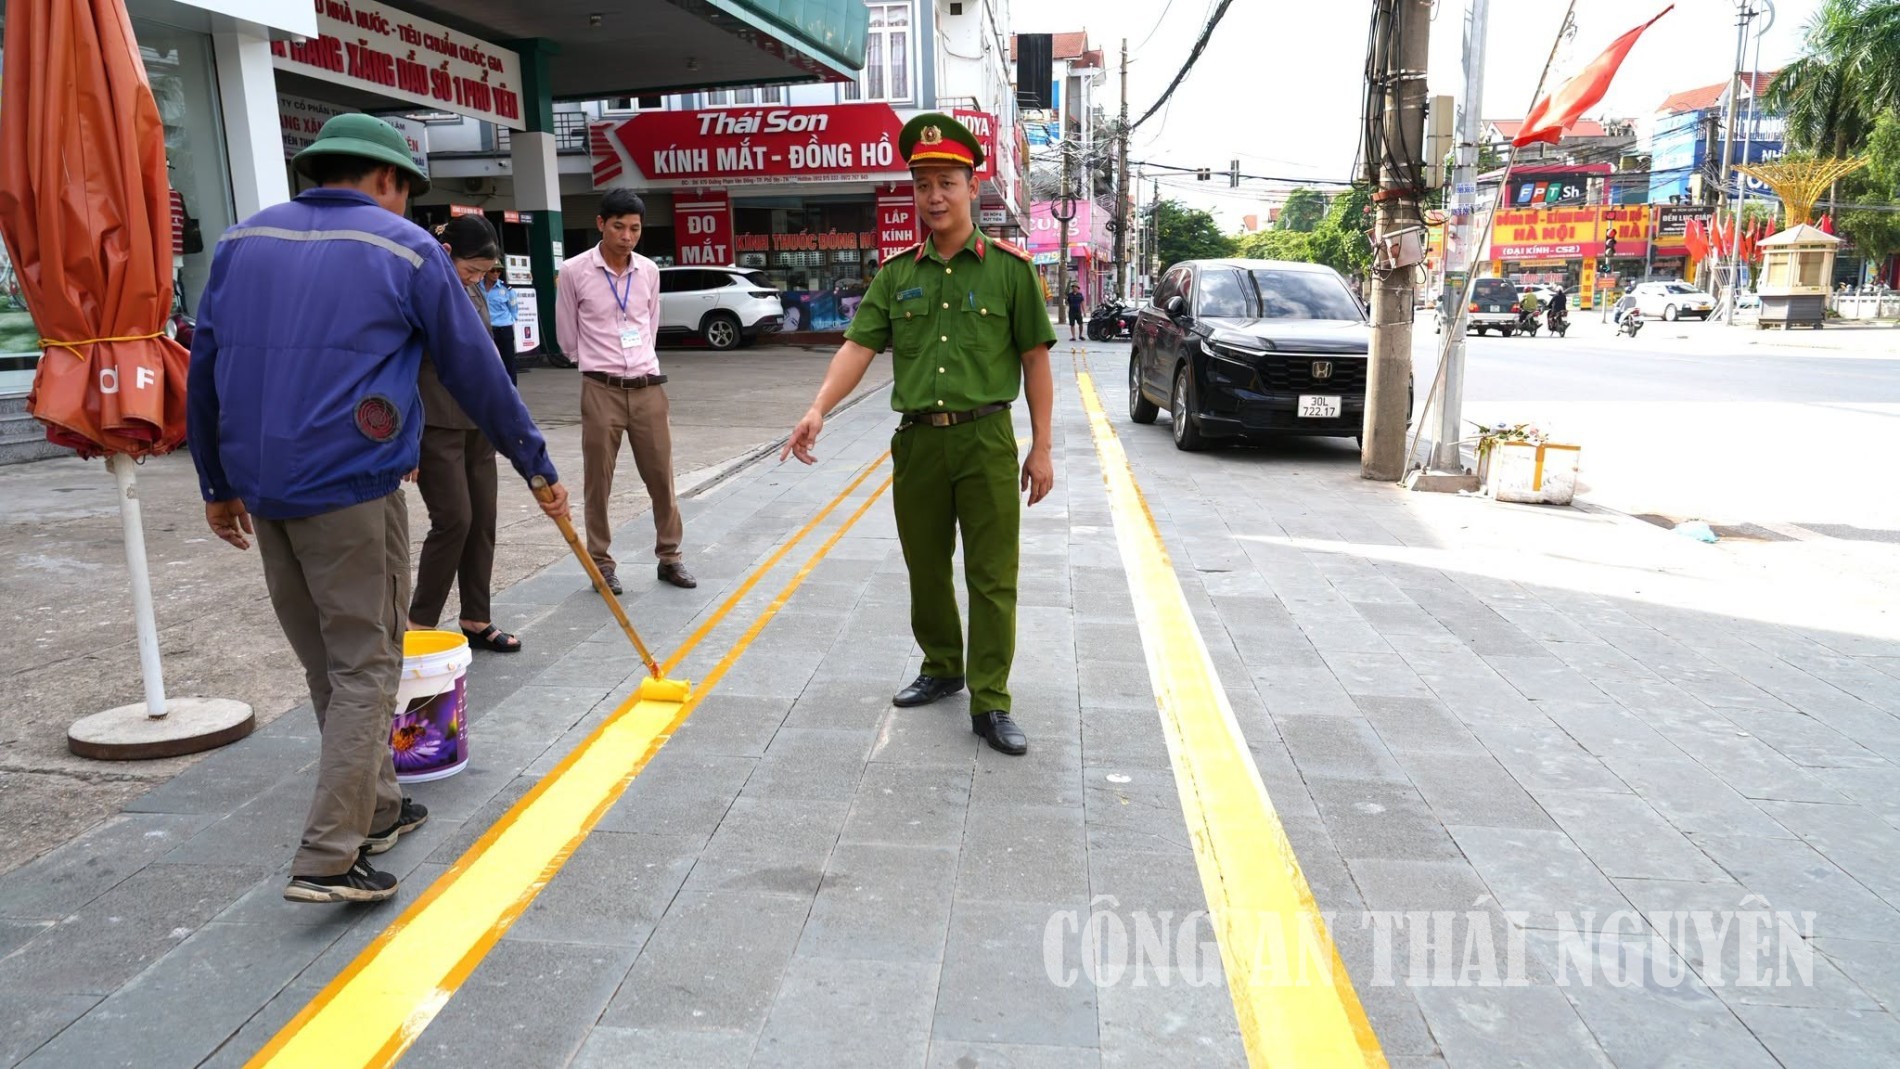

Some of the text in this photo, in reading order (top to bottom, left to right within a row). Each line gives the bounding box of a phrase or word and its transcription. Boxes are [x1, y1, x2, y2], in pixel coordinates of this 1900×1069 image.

[355, 10, 390, 36] NƯỚC
[398, 24, 422, 47] TIÊU
[424, 32, 460, 58] CHUẨN
[460, 42, 487, 67] QUỐC
[488, 54, 504, 74] GIA
[345, 38, 396, 88] XĂNG
[396, 50, 430, 96] DẦU
[430, 61, 452, 102] SỐ
[452, 79, 463, 106] 1
[462, 70, 492, 112] PHỔ
[493, 83, 520, 120] YÊN
[696, 109, 829, 136] Thái Sơn
[653, 143, 710, 174] KÍNH
[716, 136, 768, 172] MẮT
[788, 133, 853, 169] ĐỒNG
[861, 131, 893, 167] HỒ
[687, 215, 716, 235] ĐO
[882, 229, 913, 242] KÍNH
[1514, 224, 1576, 241] HÀ NỘI
[735, 231, 769, 251] KÍNH
[773, 228, 817, 251] THUỐC
[818, 227, 856, 250] ĐỒNG
[1526, 244, 1549, 255] KÍNH
[682, 238, 727, 265] MẮT
[1303, 406, 1336, 417] 722.17
[1310, 396, 1329, 407] 30L
